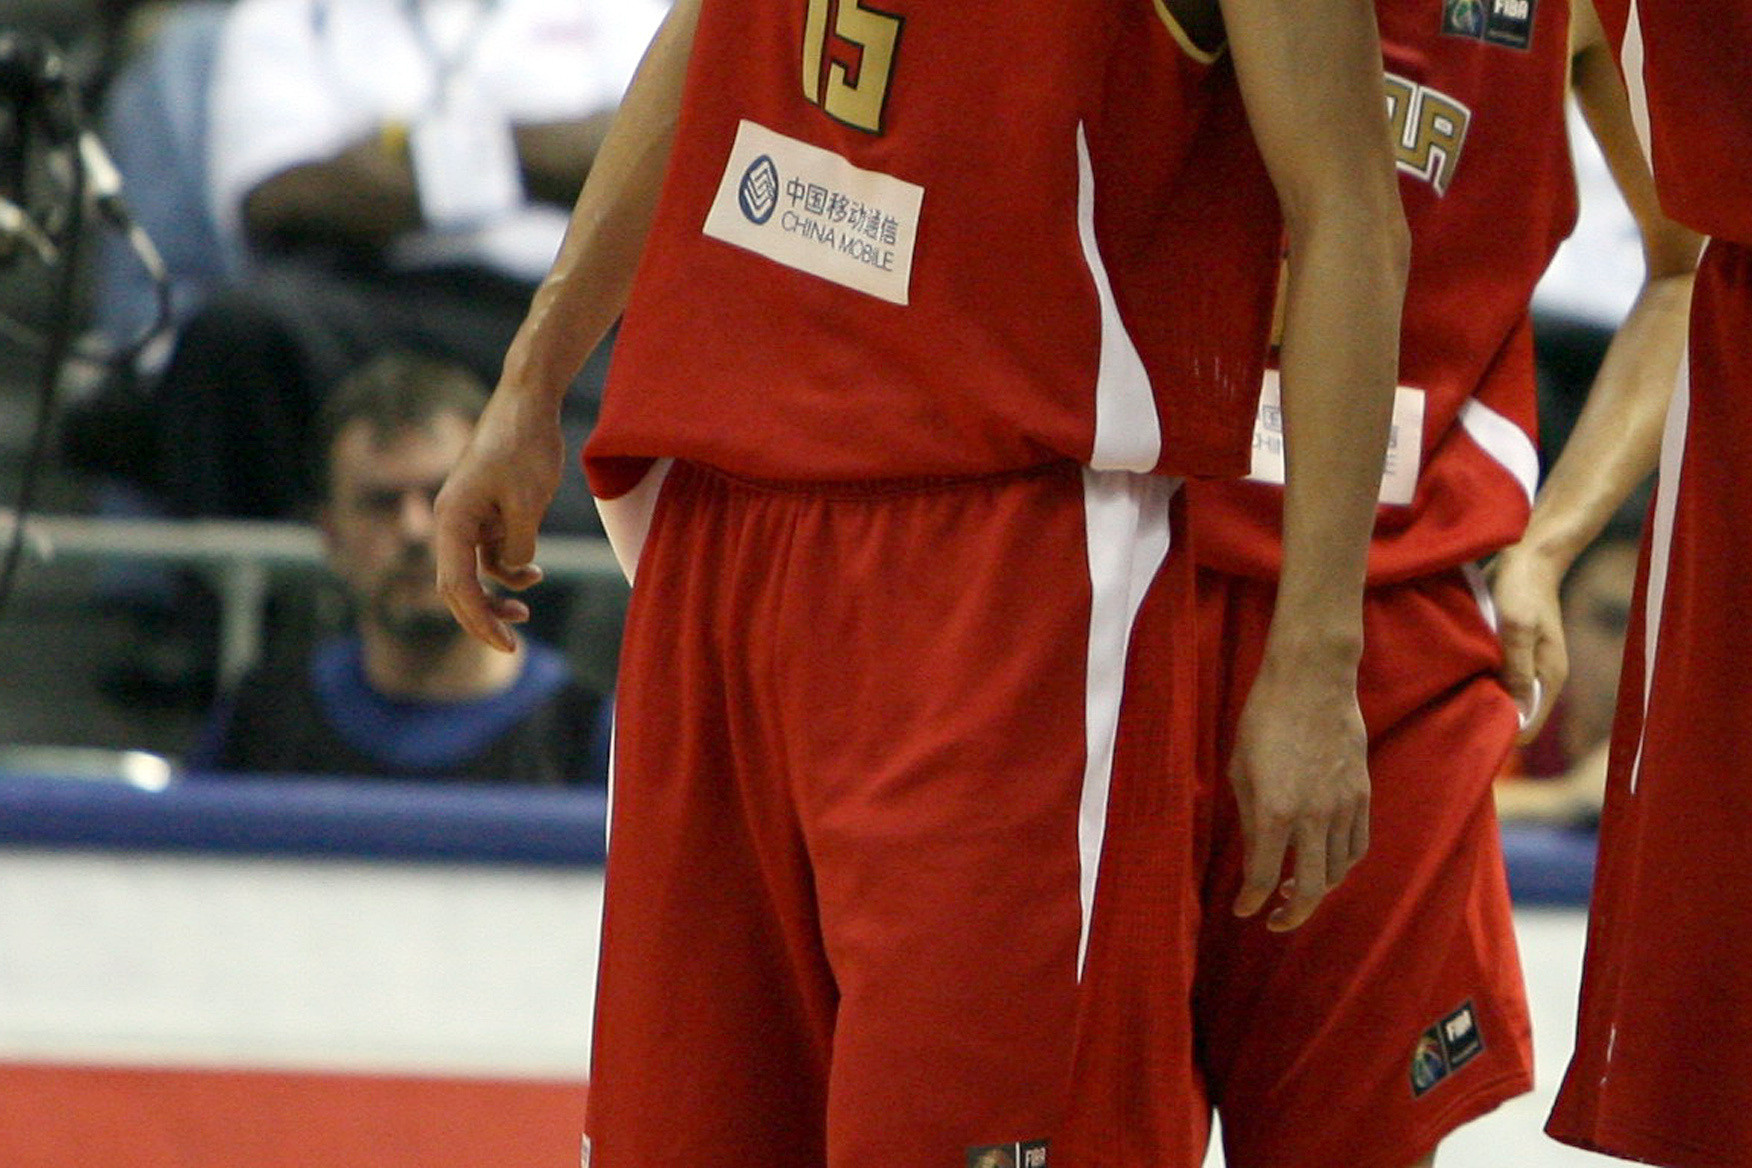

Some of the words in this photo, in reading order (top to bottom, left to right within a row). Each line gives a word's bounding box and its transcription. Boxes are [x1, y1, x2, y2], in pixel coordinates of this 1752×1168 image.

[782, 210, 836, 248] CHINA
[838, 234, 895, 272] MOBILE
[787, 177, 899, 245] 中国移动通信
